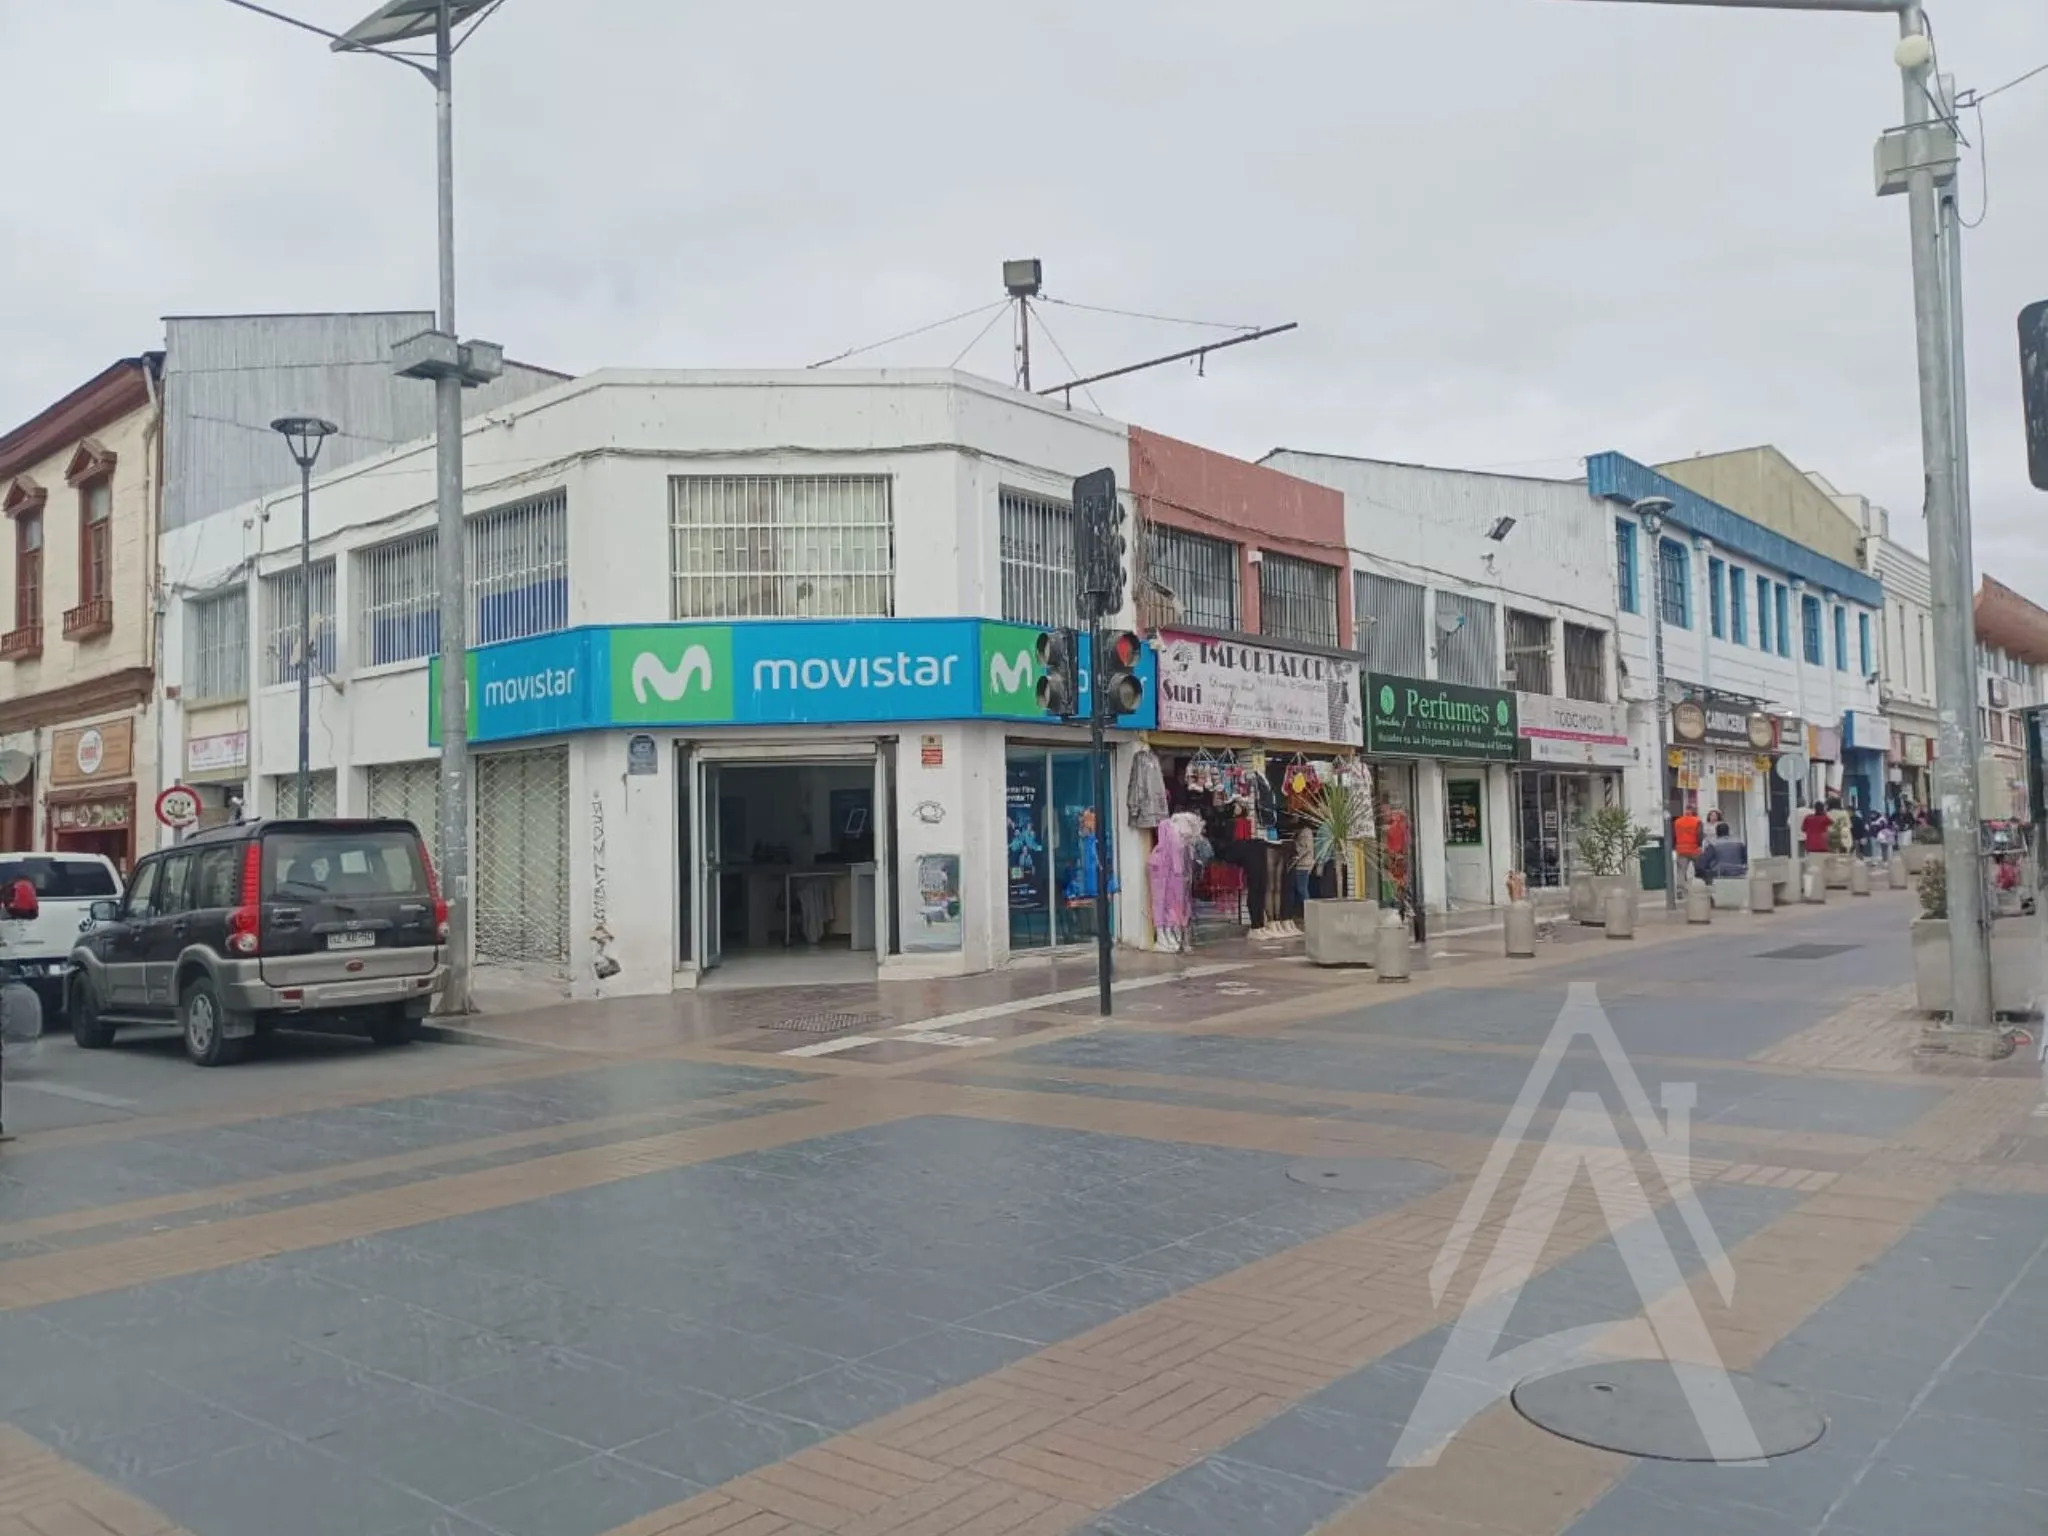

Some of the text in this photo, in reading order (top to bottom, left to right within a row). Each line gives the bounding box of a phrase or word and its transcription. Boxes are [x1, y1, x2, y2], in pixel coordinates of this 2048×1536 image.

[485, 668, 576, 707] movistar
[753, 652, 959, 690] movistar
[1162, 678, 1201, 704] Suri
[1405, 688, 1489, 724] Perfumes
